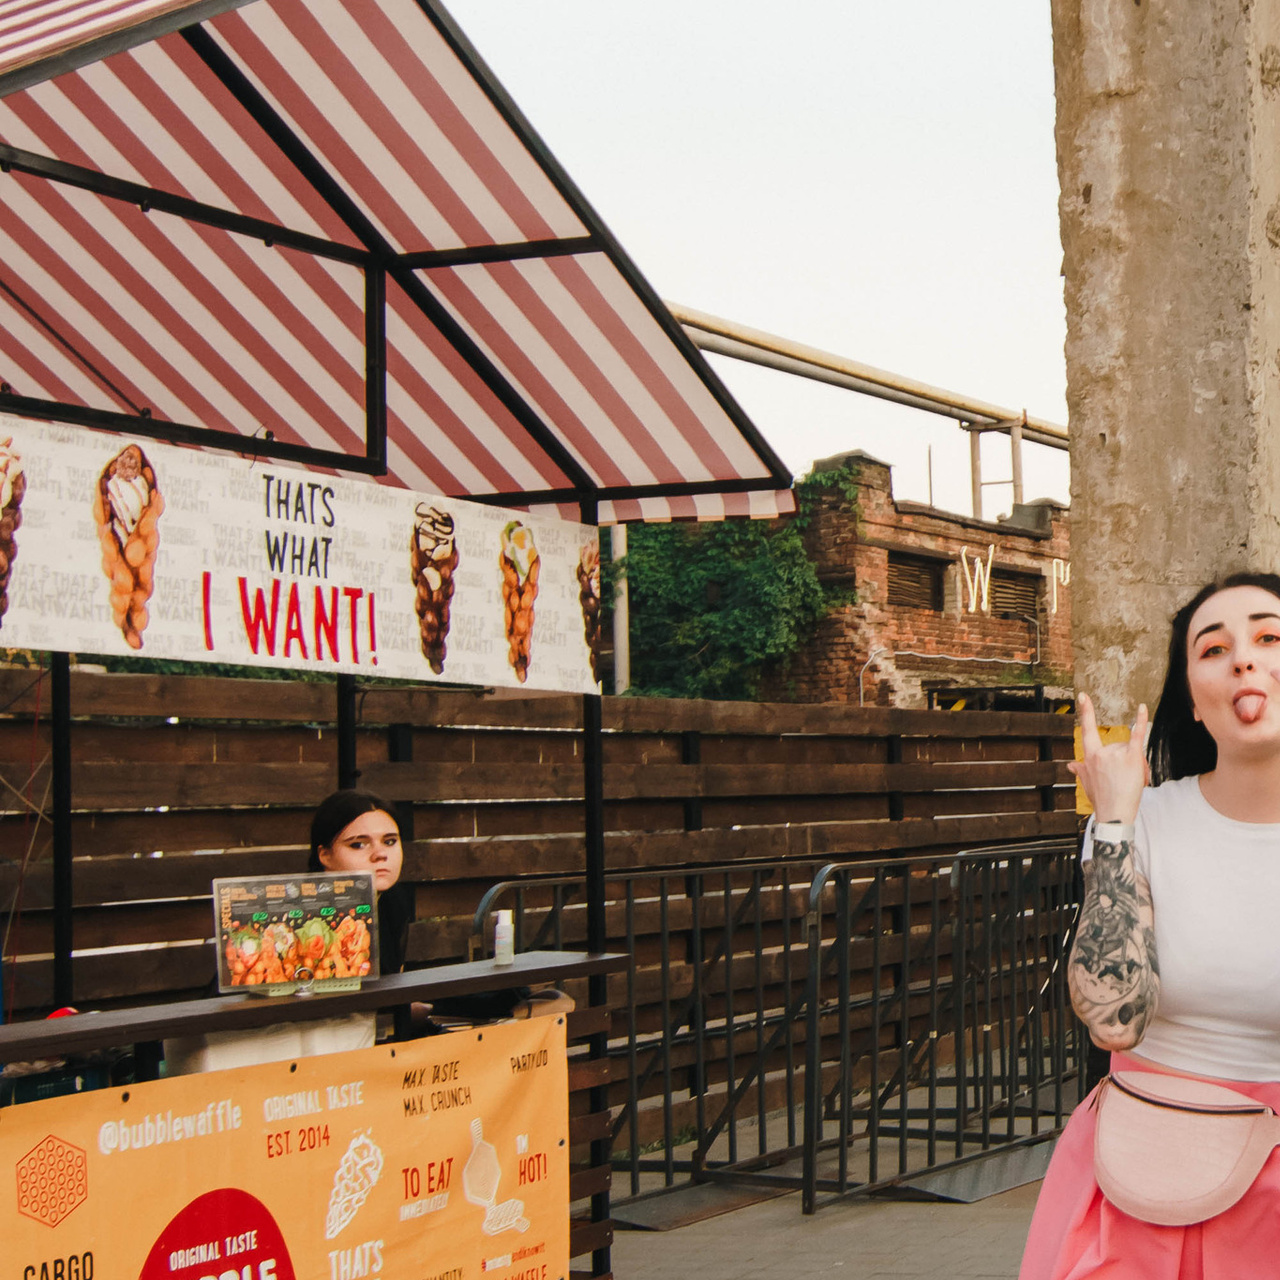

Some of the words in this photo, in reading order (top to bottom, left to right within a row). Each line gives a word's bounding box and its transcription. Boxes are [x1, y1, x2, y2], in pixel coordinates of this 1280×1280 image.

[263, 474, 335, 527] THAT'S
[266, 530, 332, 578] WHAT
[203, 571, 214, 651] I
[238, 576, 378, 666] WANT!
[432, 1060, 460, 1084] TASTE
[264, 1090, 322, 1122] ORIGINAL
[326, 1080, 364, 1110] TASTE
[430, 1086, 472, 1112] CRUNCH
[98, 1099, 242, 1156] @bubblewaffle
[267, 1130, 292, 1158] EST.
[299, 1124, 330, 1152] 2014
[402, 1167, 420, 1200] TO
[428, 1158, 454, 1194] EAT
[518, 1153, 547, 1186] HOT!
[170, 1241, 220, 1271] ORIGINAL
[225, 1230, 258, 1256] TASTE
